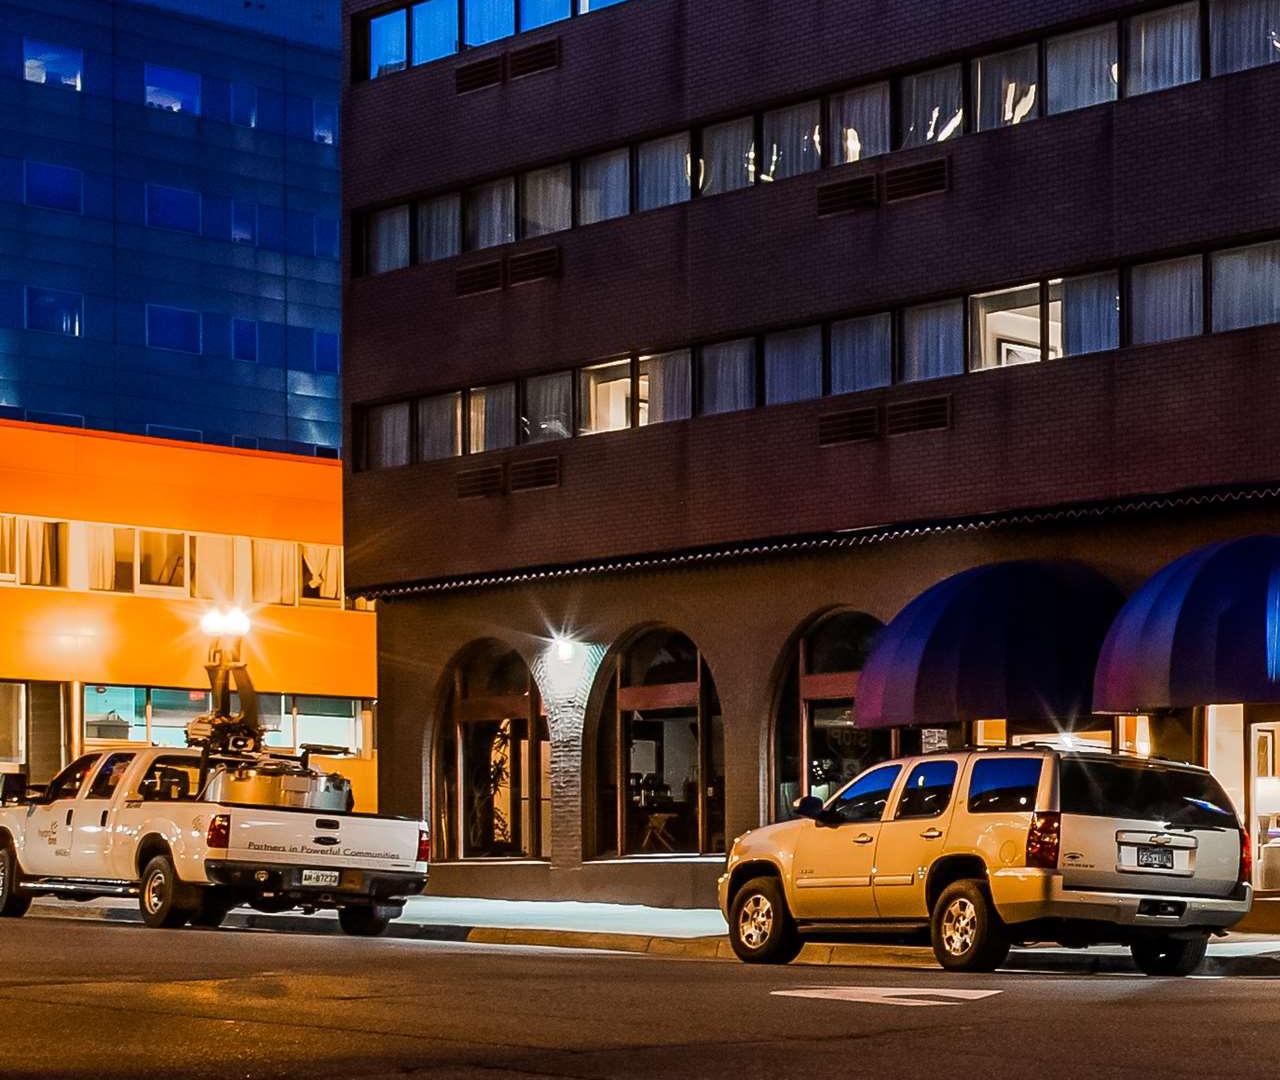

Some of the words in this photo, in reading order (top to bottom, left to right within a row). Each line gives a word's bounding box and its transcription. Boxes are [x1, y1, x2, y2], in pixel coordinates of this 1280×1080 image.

[247, 841, 287, 853] Partners
[289, 844, 299, 854] in
[300, 846, 341, 857] Powerful
[342, 848, 401, 860] Communities
